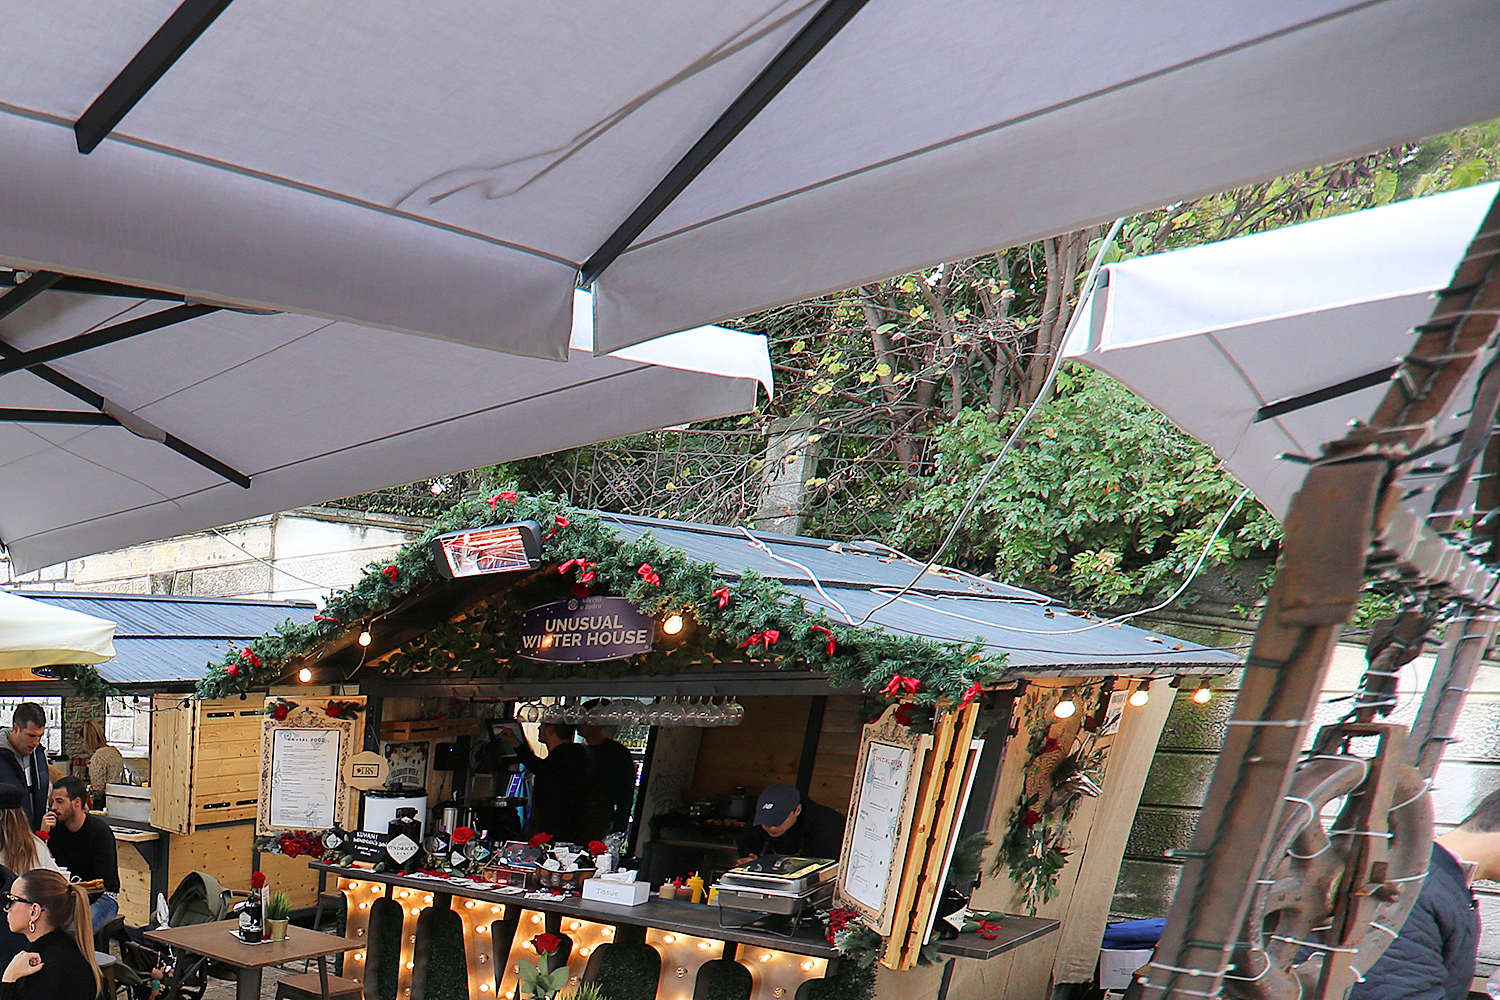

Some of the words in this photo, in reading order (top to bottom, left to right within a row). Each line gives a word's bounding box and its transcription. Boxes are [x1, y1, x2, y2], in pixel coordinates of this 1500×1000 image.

[544, 614, 623, 633] UNUSUAL
[522, 632, 582, 649] WINTER
[585, 629, 648, 646] HOUSE
[596, 887, 619, 897] Tissue
